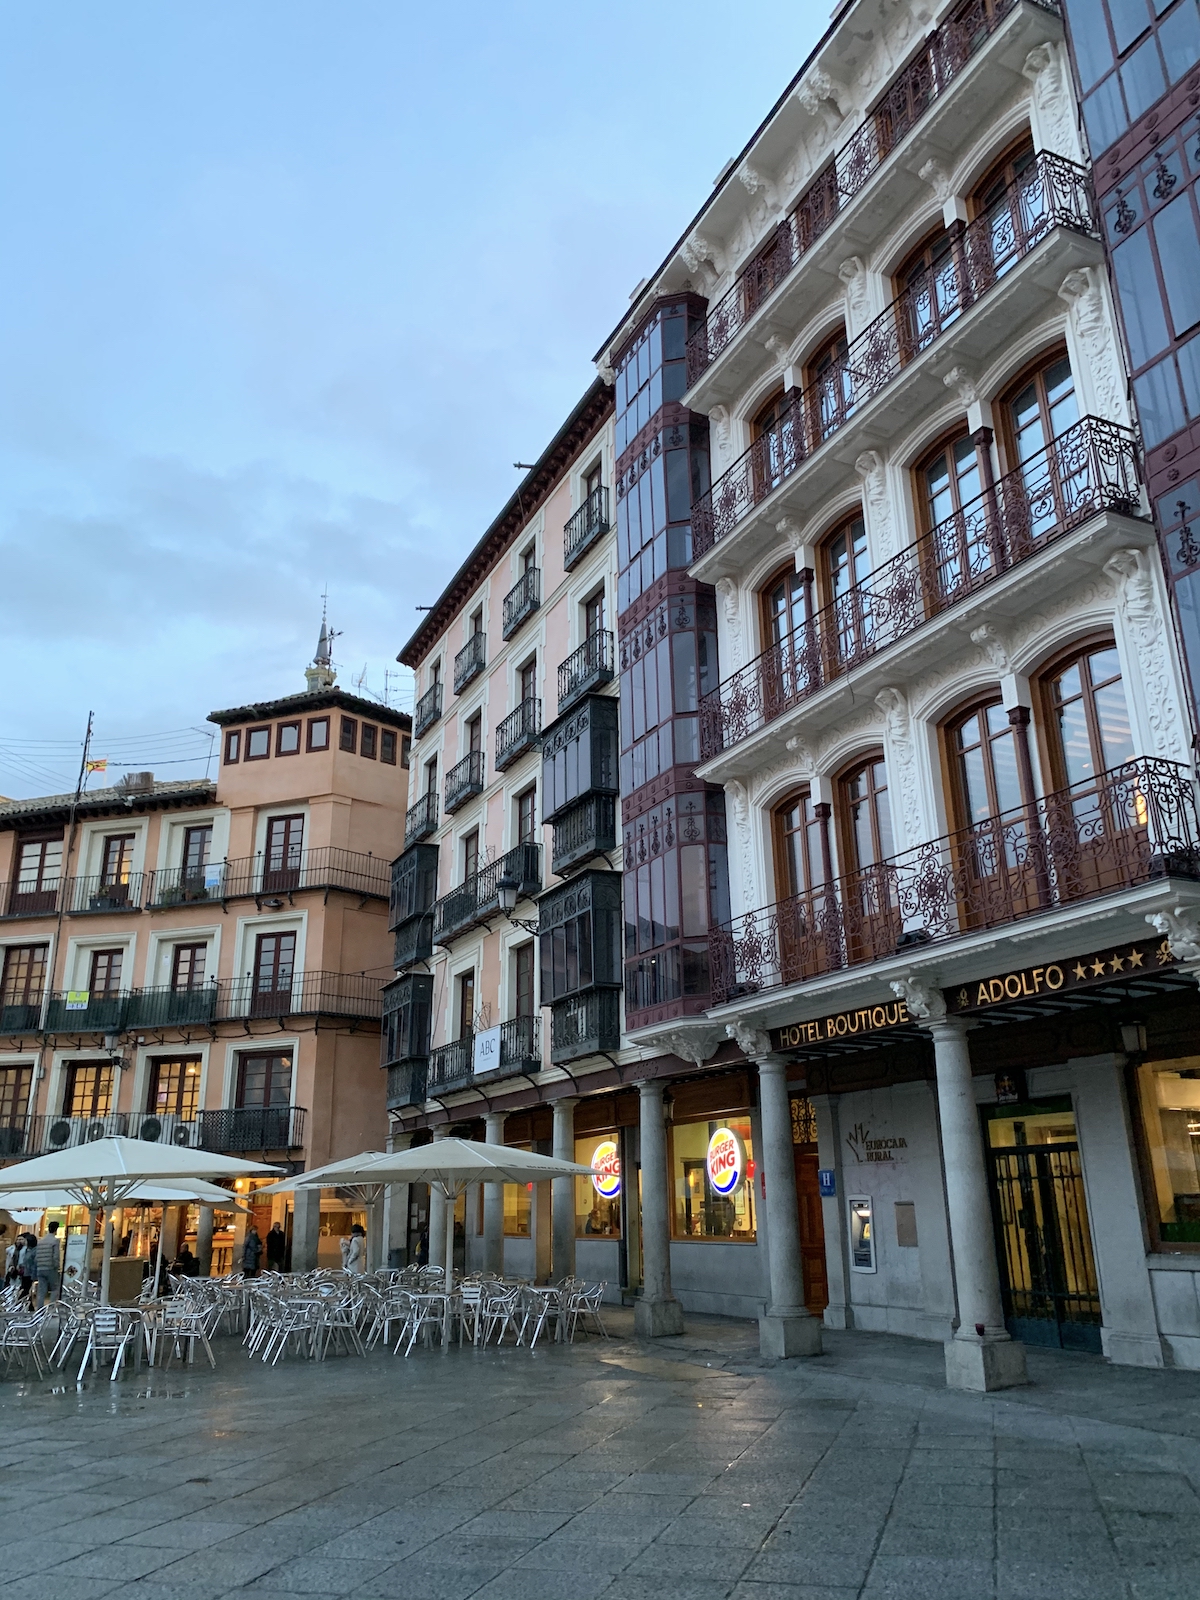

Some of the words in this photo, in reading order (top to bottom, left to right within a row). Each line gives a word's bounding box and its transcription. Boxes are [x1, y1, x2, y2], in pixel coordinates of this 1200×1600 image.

[977, 965, 1064, 1006] ADOLFO
[780, 1021, 824, 1047] HOTEL
[826, 1001, 909, 1038] BOUTIQUE
[479, 1038, 496, 1057] ABC
[710, 1139, 735, 1162] BURGER
[865, 1151, 895, 1162] RURAL
[711, 1150, 736, 1179] KING
[822, 1172, 832, 1186] H
